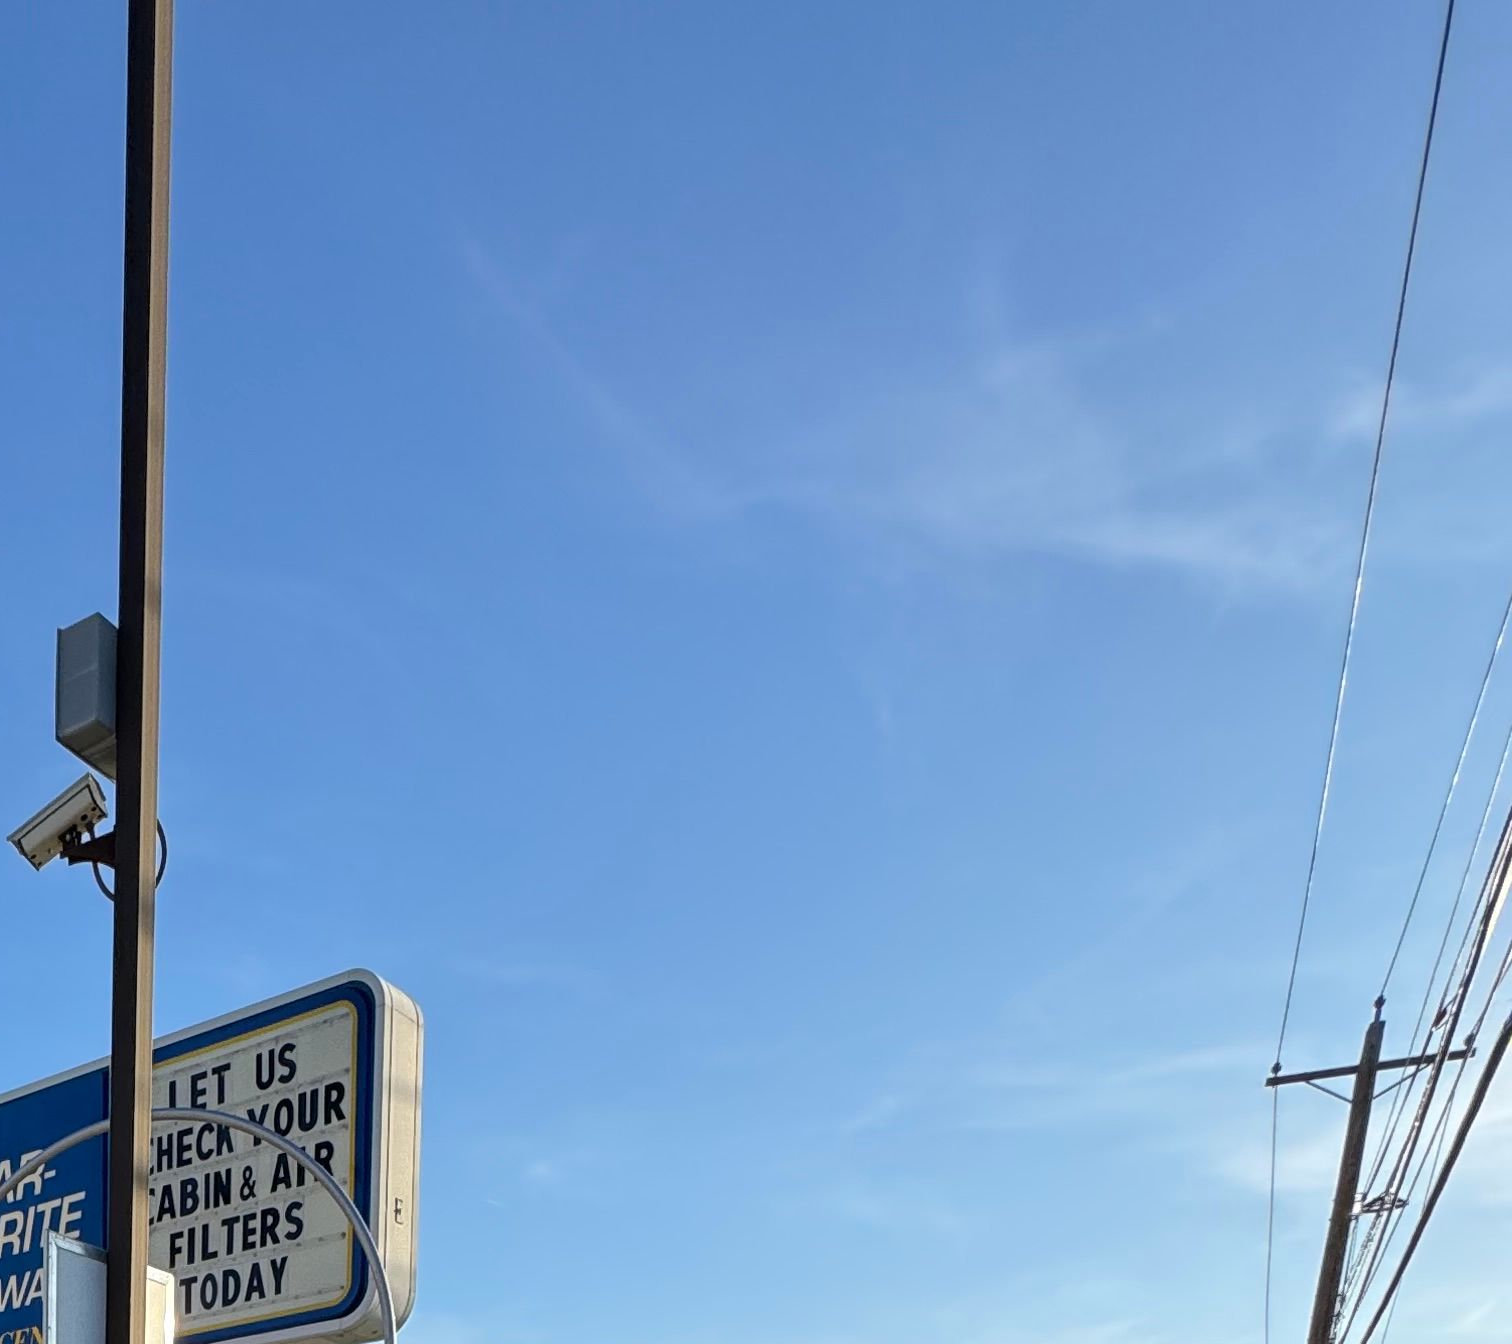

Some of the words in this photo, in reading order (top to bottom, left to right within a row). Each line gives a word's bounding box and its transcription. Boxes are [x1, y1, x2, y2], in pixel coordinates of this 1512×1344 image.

[256, 1043, 296, 1090] US
[150, 1123, 234, 1175] HECK
[247, 1081, 346, 1147] YOUR
[149, 1168, 232, 1226] ABIN
[239, 1165, 257, 1201] &
[270, 1140, 335, 1193] AIR
[169, 1201, 304, 1269] FILTERS
[179, 1256, 288, 1315] TODAY
